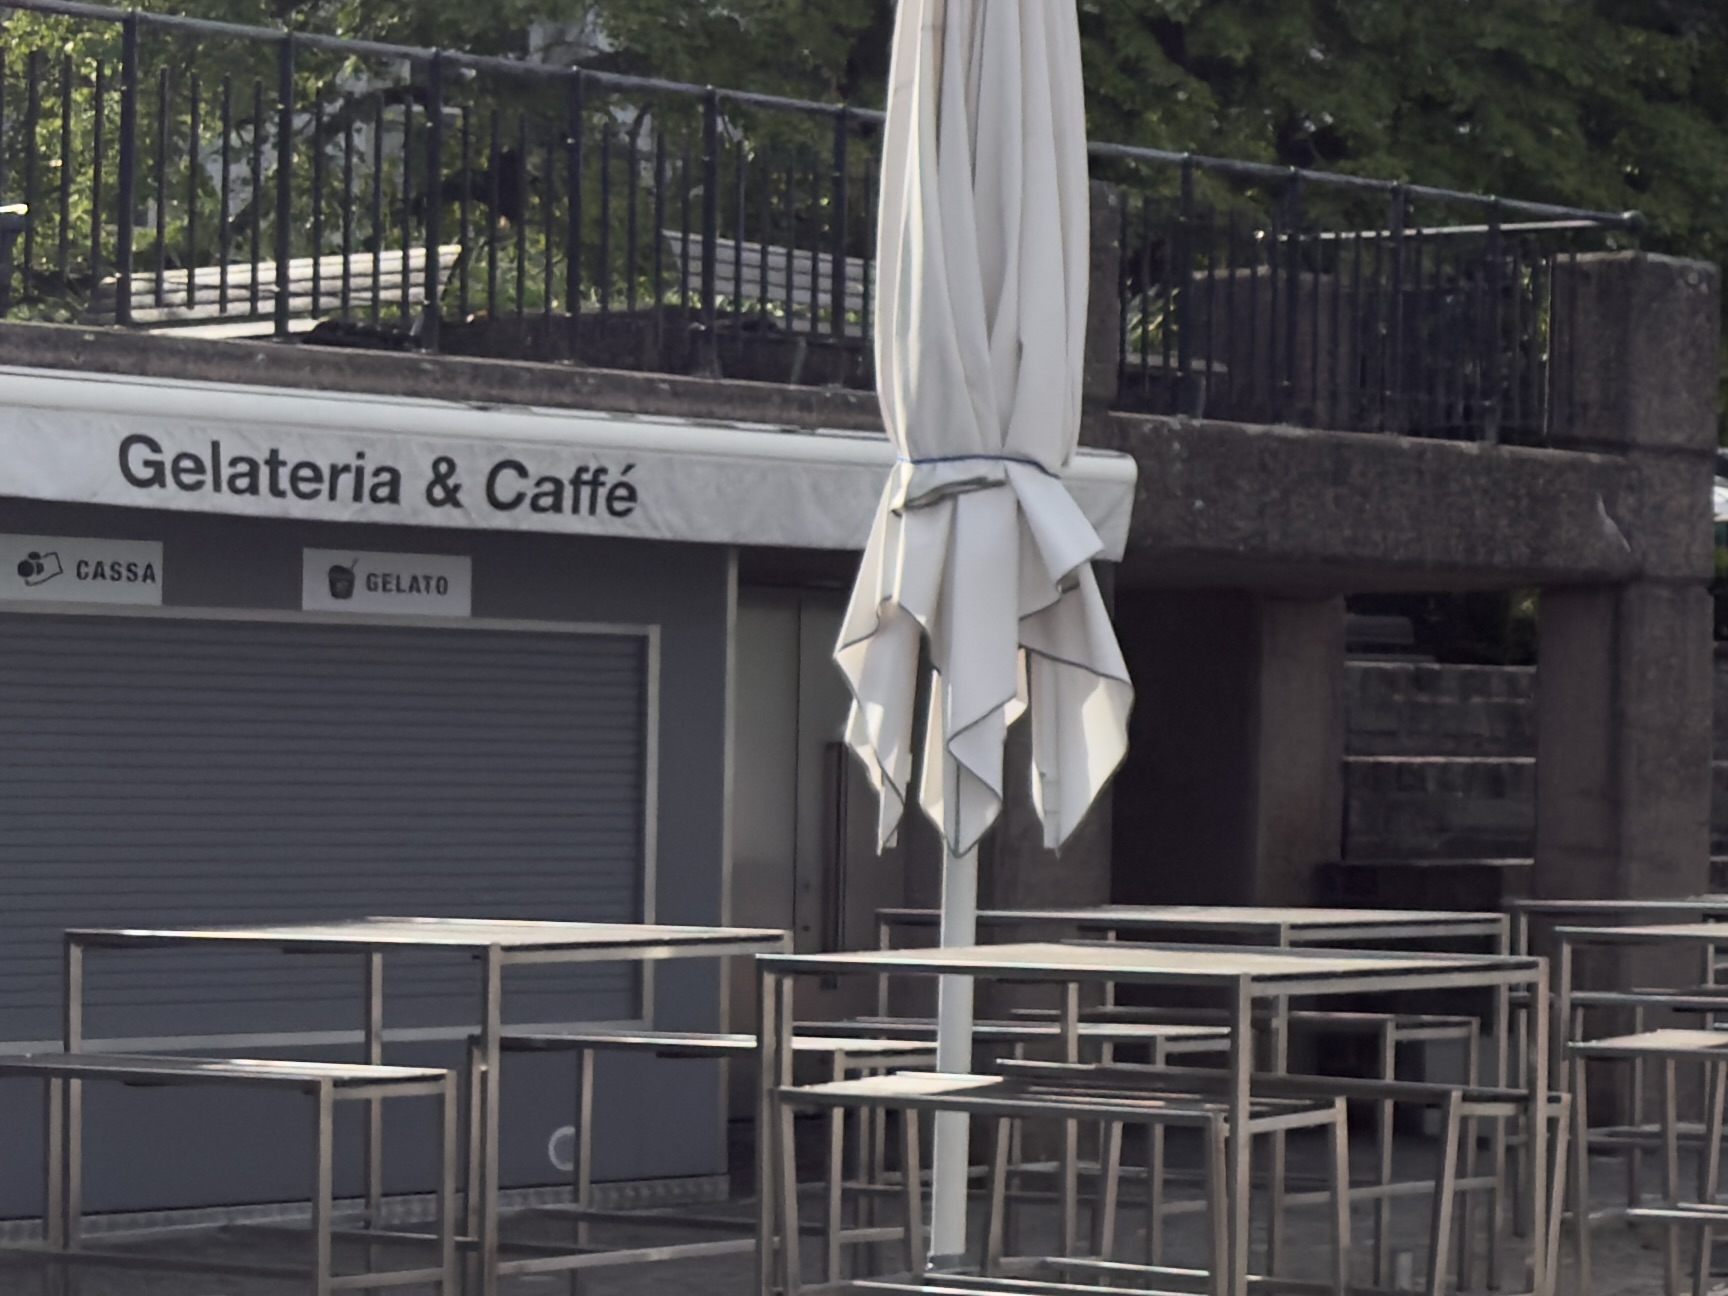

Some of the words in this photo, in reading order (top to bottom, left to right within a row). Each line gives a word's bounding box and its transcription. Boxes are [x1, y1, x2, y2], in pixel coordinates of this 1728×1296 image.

[118, 433, 402, 505] Gelateria
[425, 456, 464, 508] &
[485, 459, 638, 518] Caffé
[76, 560, 156, 584] CASSA
[365, 572, 449, 597] GELATO
